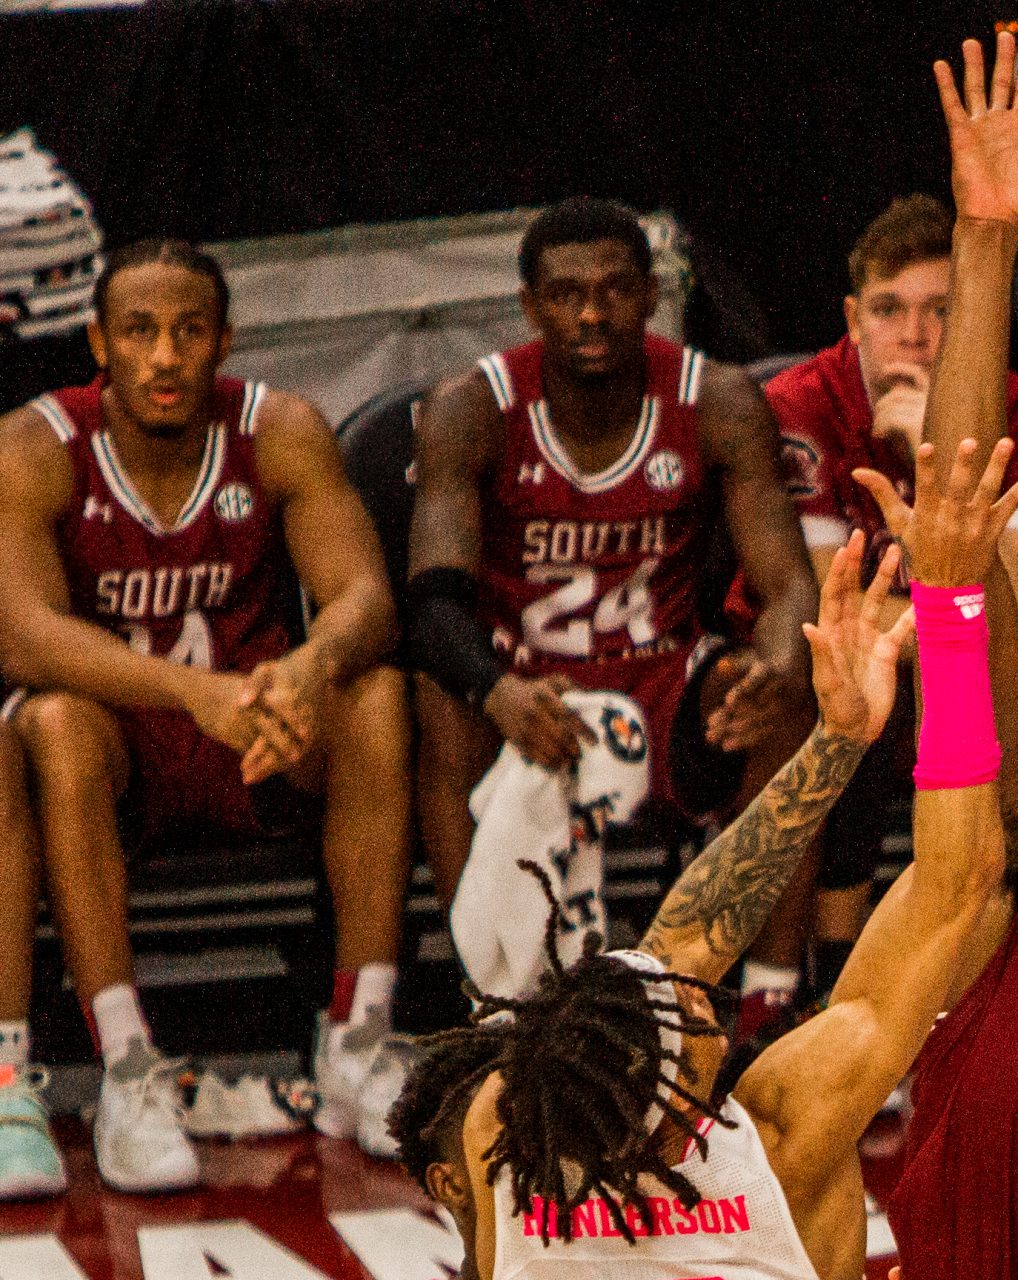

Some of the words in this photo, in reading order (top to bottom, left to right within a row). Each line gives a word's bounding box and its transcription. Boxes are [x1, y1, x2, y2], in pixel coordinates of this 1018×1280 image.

[522, 517, 667, 564] SOUTH
[97, 563, 235, 619] SOUTH
[520, 557, 662, 658] 24
